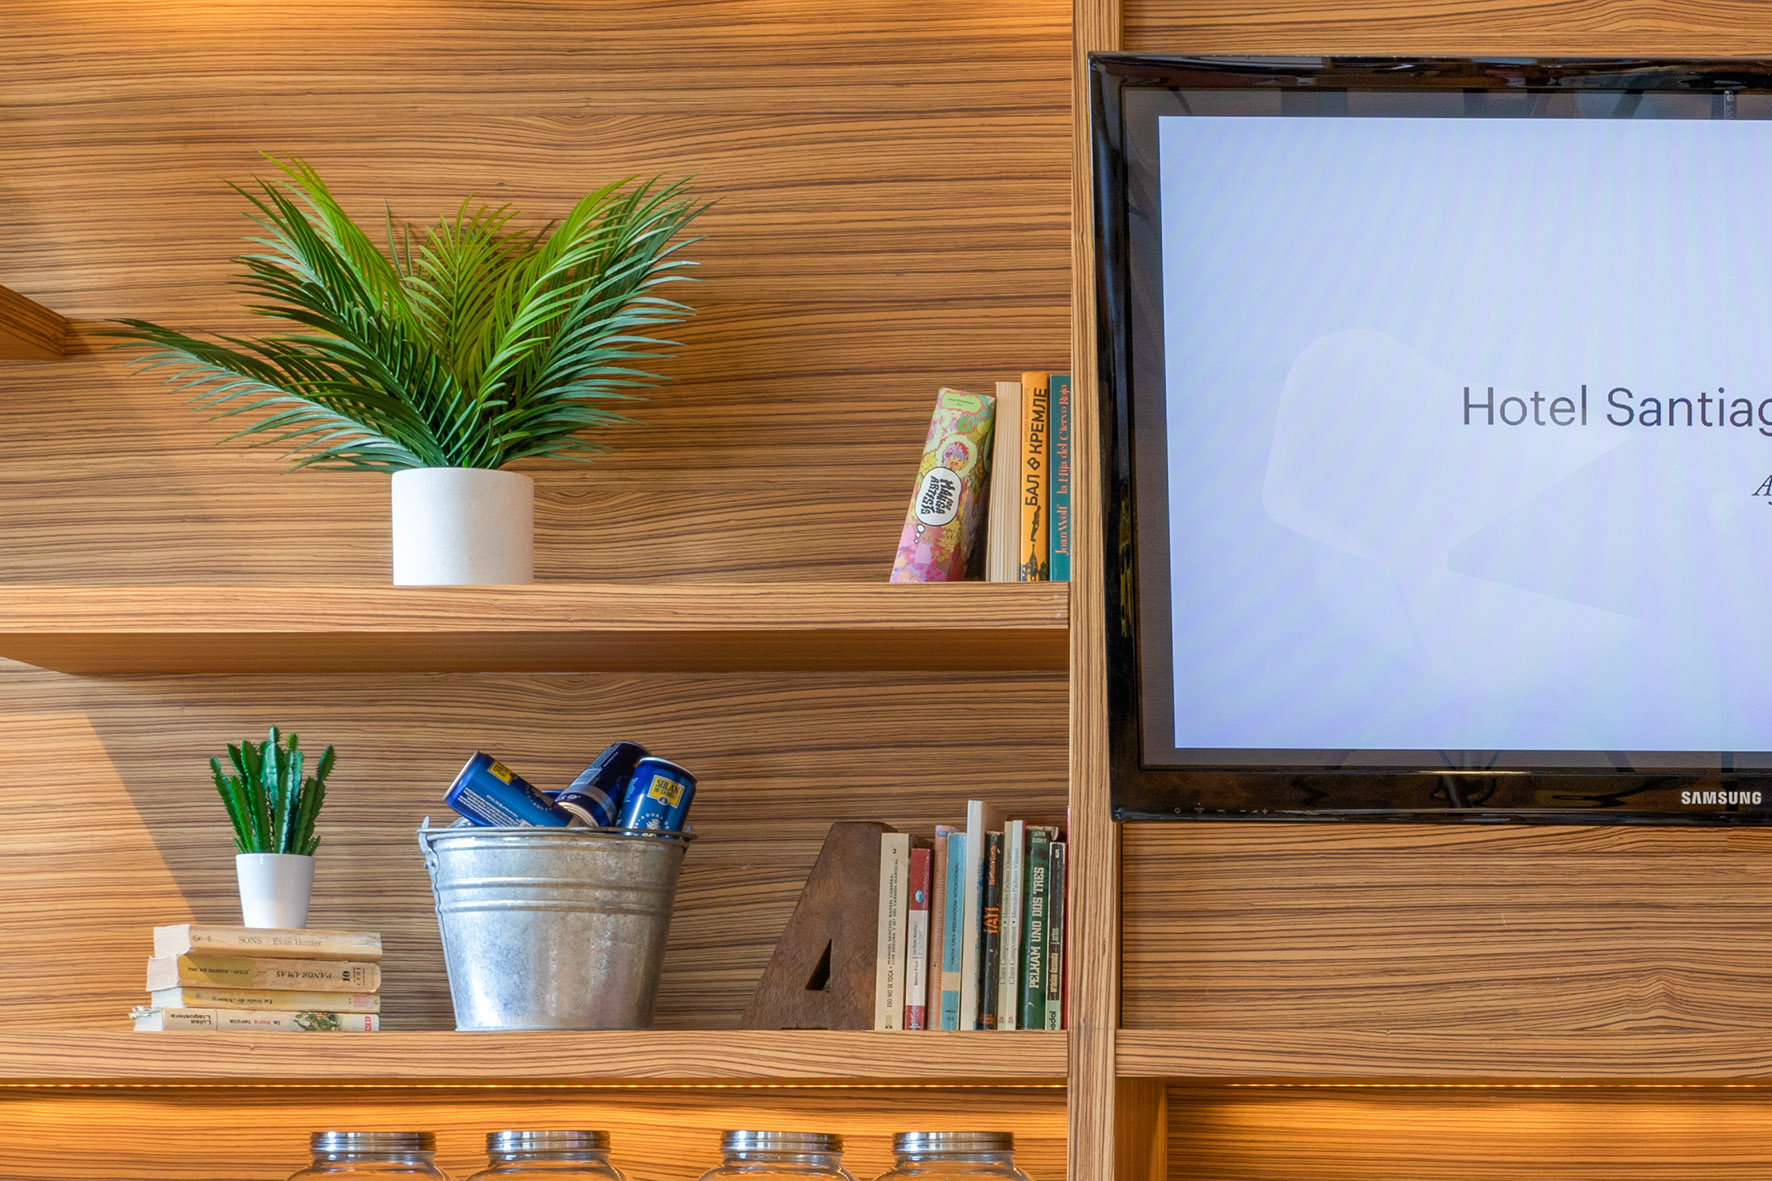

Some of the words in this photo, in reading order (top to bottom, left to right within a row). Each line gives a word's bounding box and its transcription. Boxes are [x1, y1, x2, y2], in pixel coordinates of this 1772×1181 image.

[1058, 384, 1071, 405] Rojo
[1463, 385, 1587, 426] Hotel
[1029, 387, 1048, 454] КРЕМЛЕ
[1058, 406, 1069, 440] Ciervo
[1056, 443, 1068, 459] del
[1058, 461, 1071, 483] Hija
[921, 475, 940, 515] ARTISTS
[935, 478, 956, 515] MANGA
[1025, 474, 1040, 506] БАЛ
[1056, 485, 1068, 494] la
[1056, 504, 1068, 531] Wolf
[1055, 532, 1069, 555] Joan
[1681, 791, 1762, 805] SAMSUNG
[1033, 867, 1044, 894] TRES
[1032, 897, 1043, 917] DOS
[238, 935, 263, 945] SONS
[272, 937, 293, 947] Evan
[294, 937, 323, 947] Hunter
[1031, 920, 1042, 942] UNO
[276, 970, 332, 979] PANORAMAS
[1029, 946, 1041, 989] PELHAM
[887, 989, 893, 997] NO
